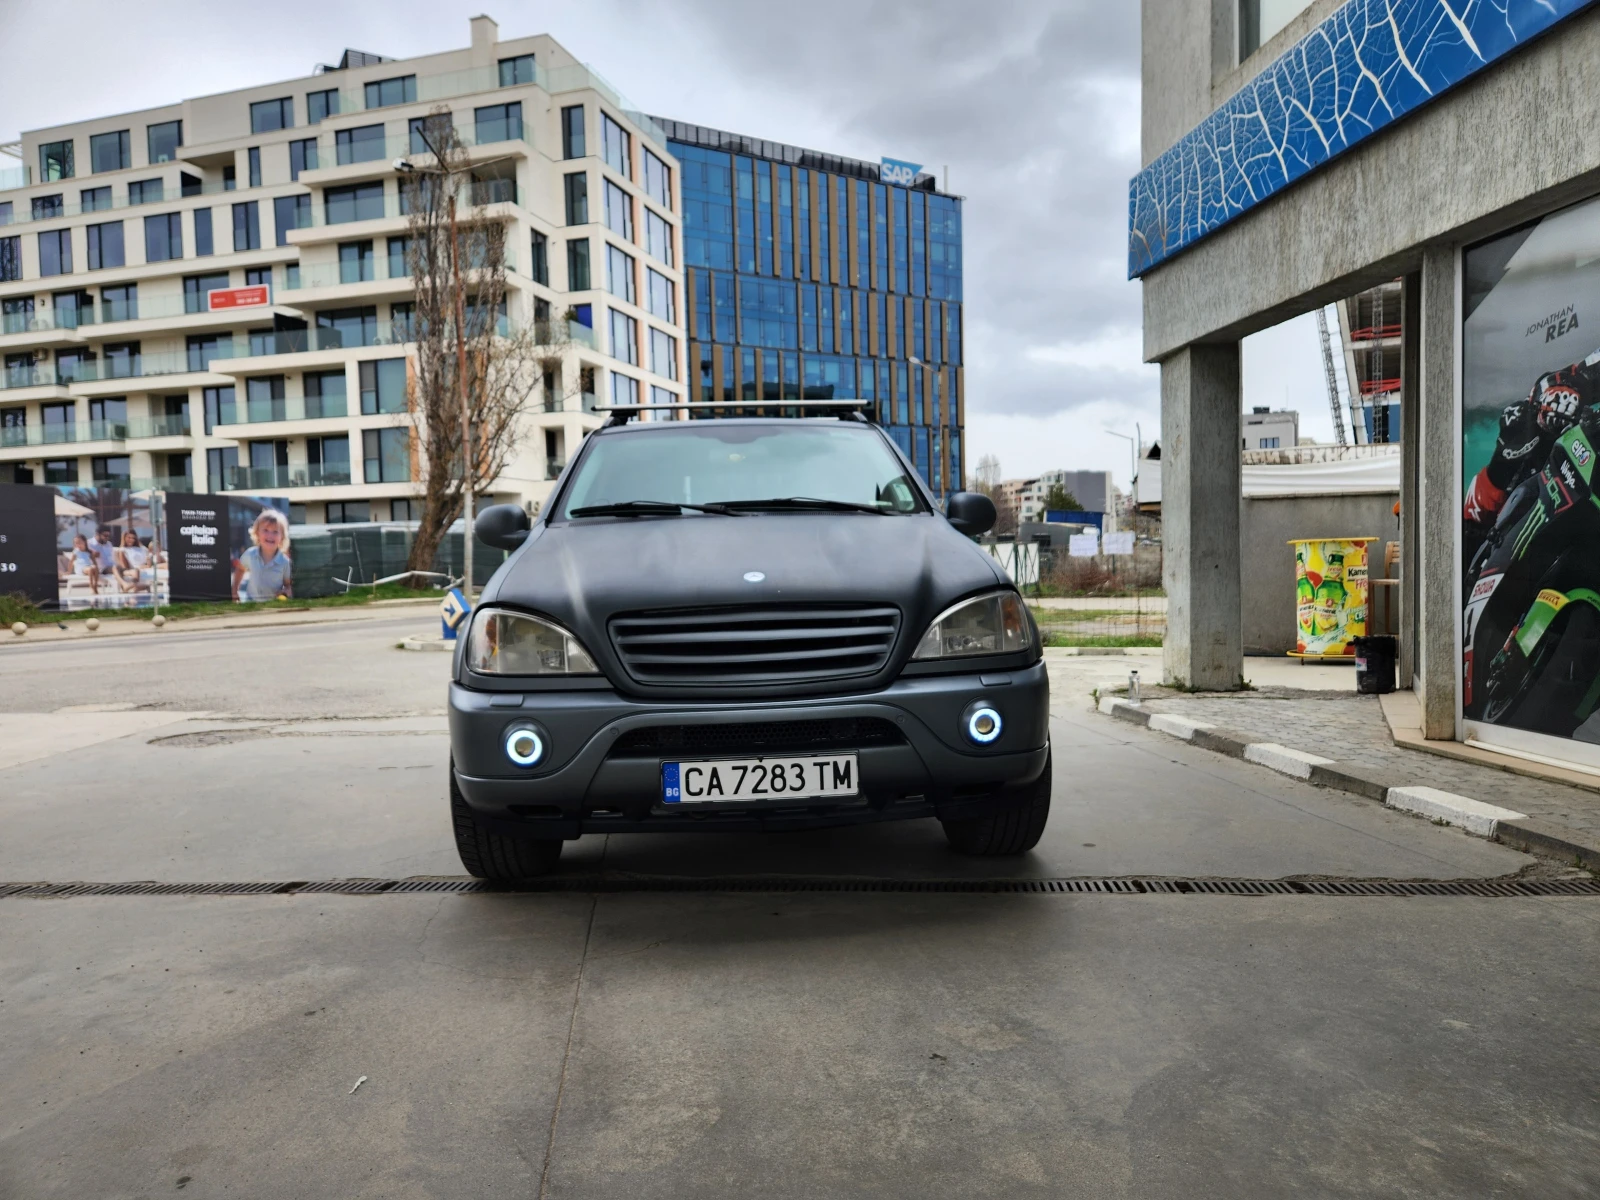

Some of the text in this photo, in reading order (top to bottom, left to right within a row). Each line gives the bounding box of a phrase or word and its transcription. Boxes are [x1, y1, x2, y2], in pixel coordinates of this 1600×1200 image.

[882, 163, 913, 184] SAP
[1525, 303, 1574, 337] JONATHAN
[1545, 312, 1579, 343] REA
[665, 787, 679, 797] BG
[685, 760, 852, 796] CA 7283 TM
